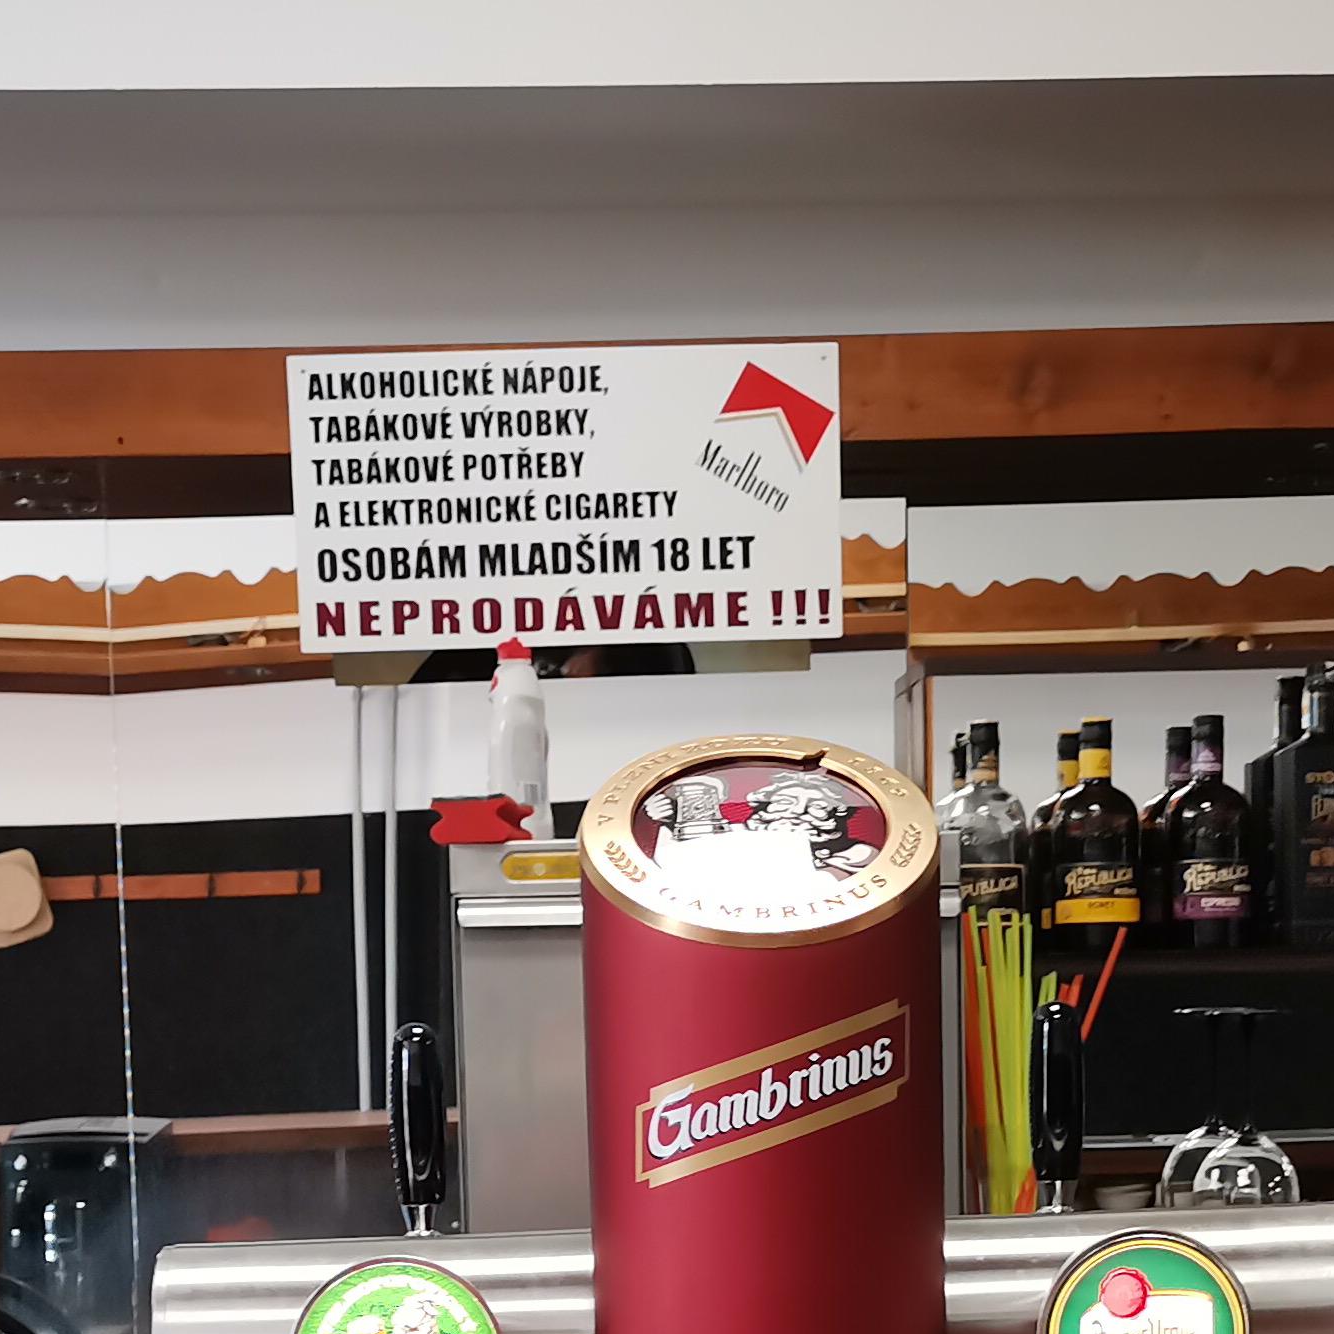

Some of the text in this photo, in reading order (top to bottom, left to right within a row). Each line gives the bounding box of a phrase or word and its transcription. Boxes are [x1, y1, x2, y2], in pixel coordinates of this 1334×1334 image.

[308, 361, 609, 400] ALKOHOLICKÉ NÁPOJE,
[310, 405, 595, 443] TABÁKOVÉ VÝROBKY,
[312, 446, 585, 486] TABÁKOVÉ POTŘEBY
[694, 438, 790, 513] Marlboro
[315, 489, 678, 528] A ELEKTRONICKÉ CIGARETY
[317, 533, 756, 583] OSOBÁM MLADŠÍM 18 LET
[316, 586, 832, 637] NEPRODÁVÁME !!!
[659, 873, 888, 920] GAMBRINUS
[647, 1036, 894, 1161] Gambrinus
